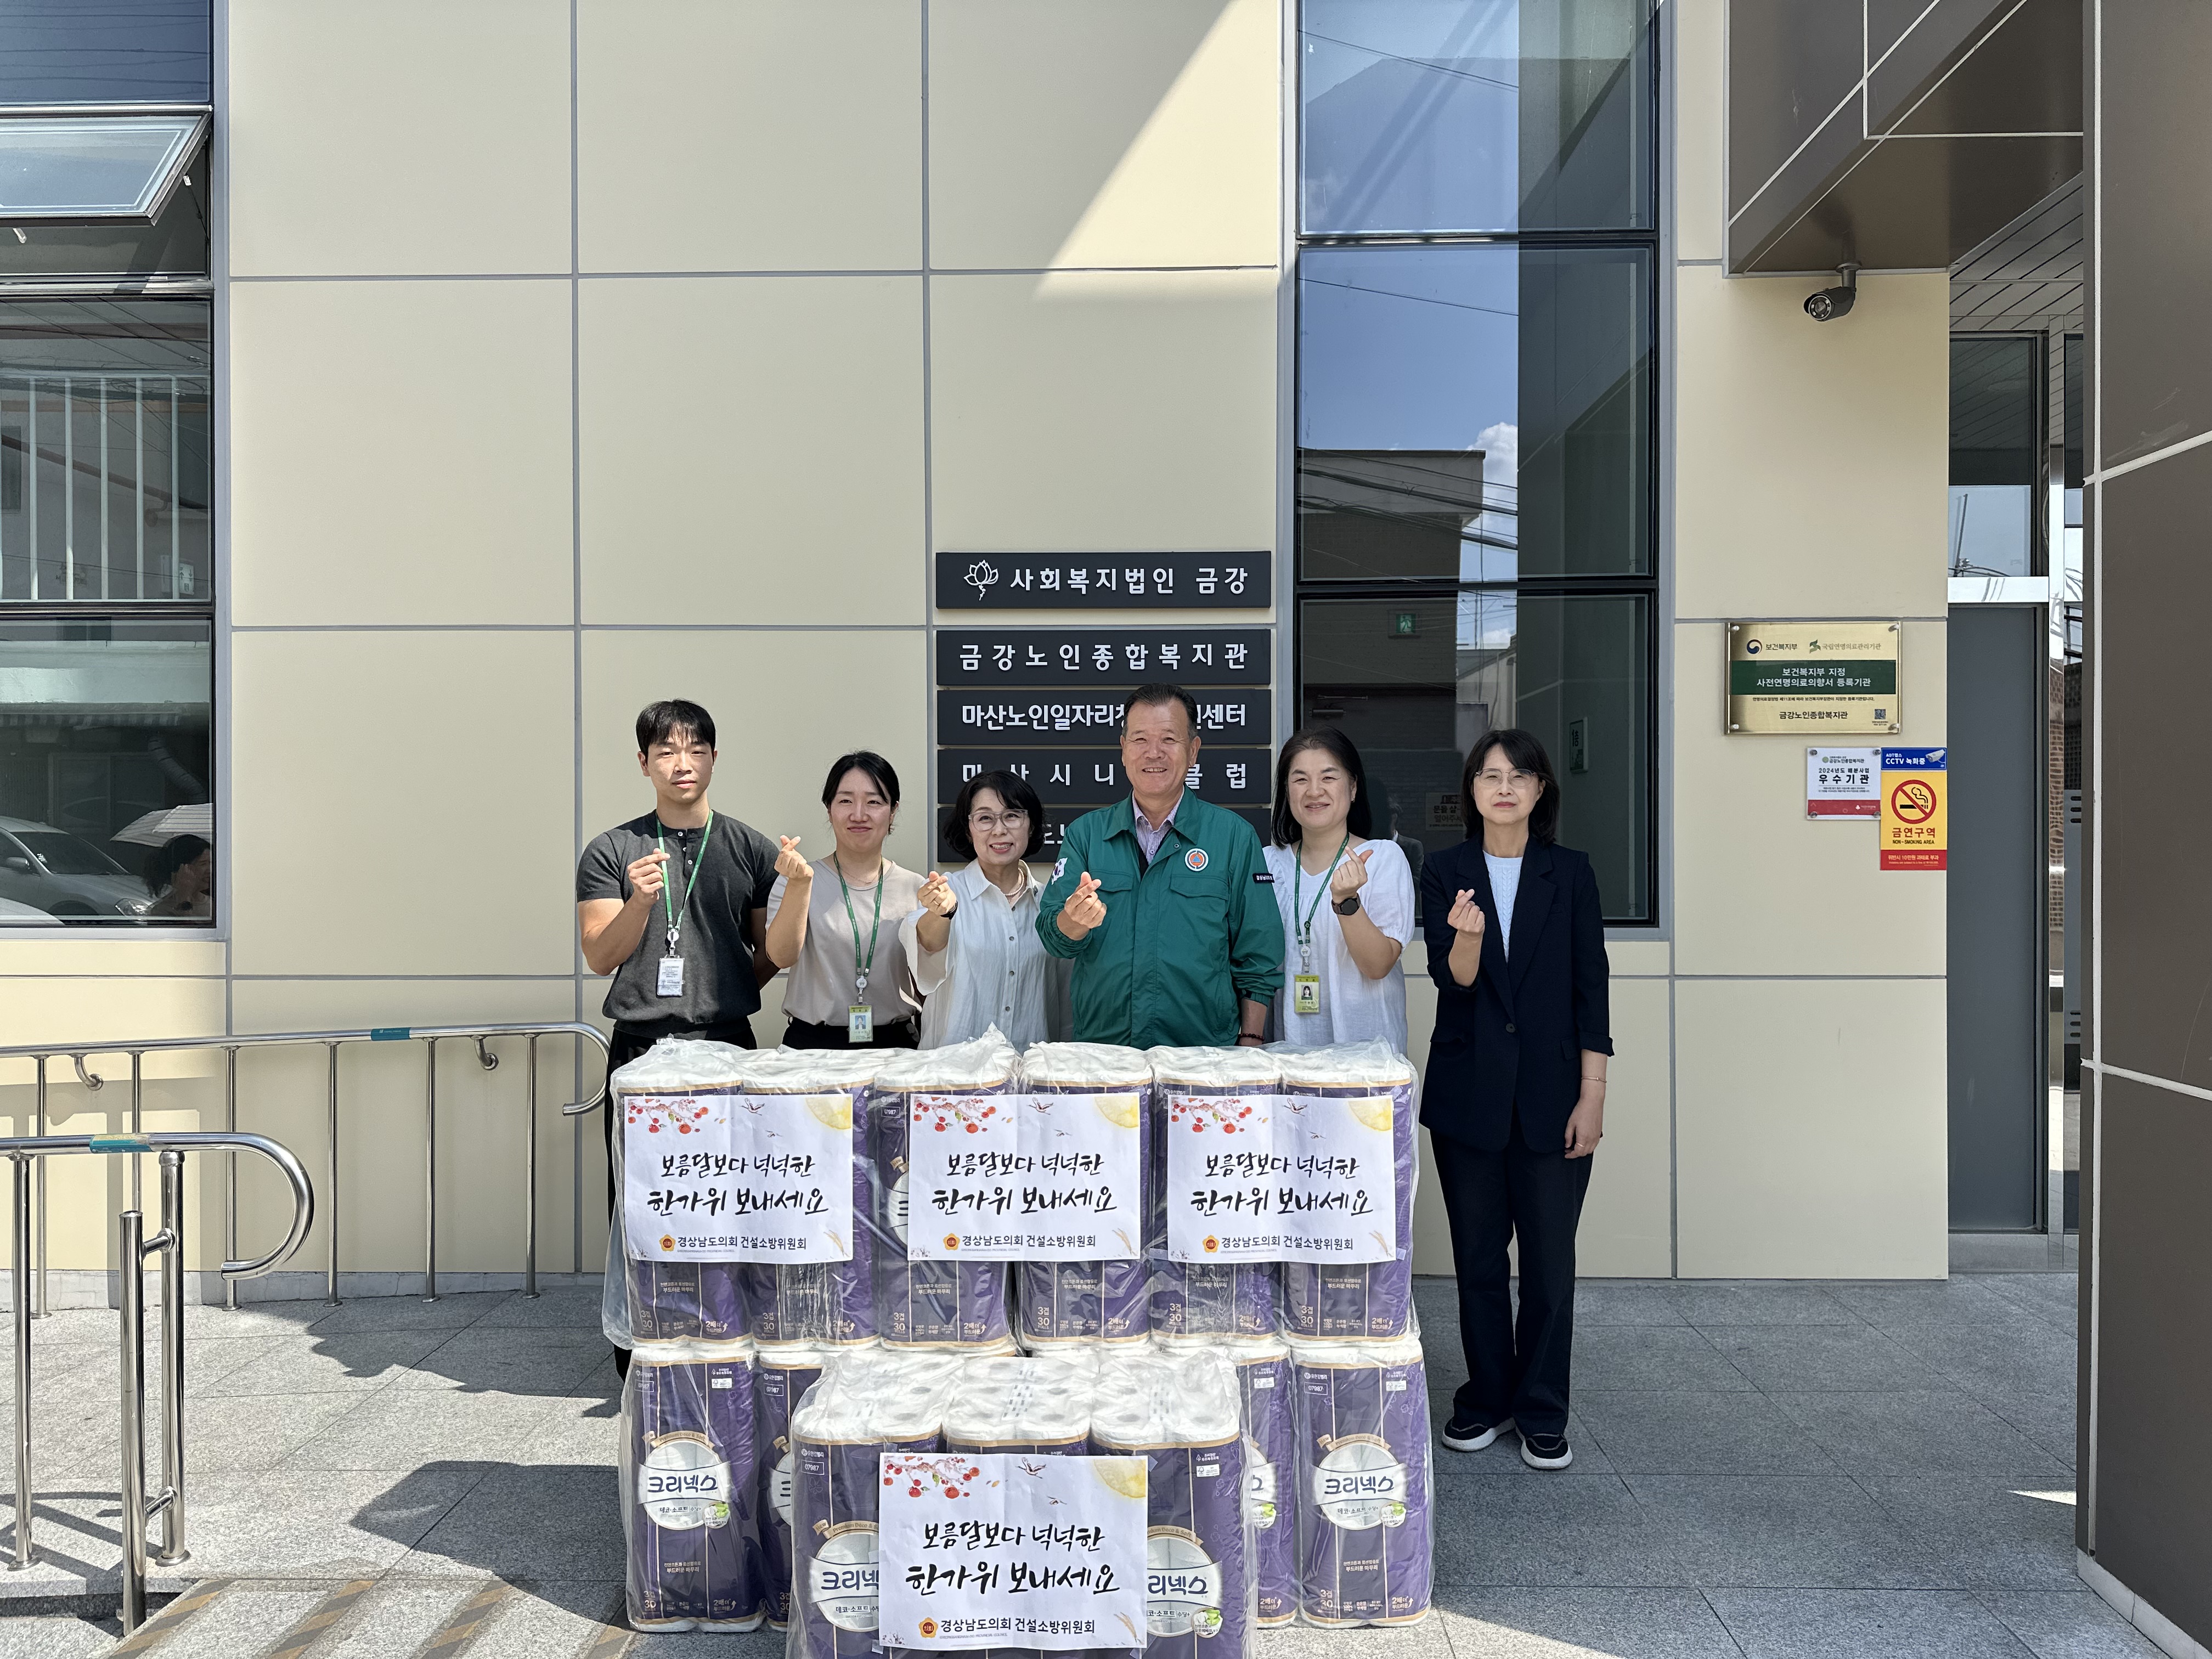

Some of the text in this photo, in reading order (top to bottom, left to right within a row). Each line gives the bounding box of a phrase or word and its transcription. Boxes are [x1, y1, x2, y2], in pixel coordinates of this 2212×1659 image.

[1010, 567, 1248, 595] 사회복지법인 금강
[960, 644, 1248, 671] 금강노인종합복지관
[1782, 668, 1846, 676] 보건복지부 지정
[1757, 678, 1871, 687] 사전연명의료의향서 등록기관
[962, 704, 1245, 730] 마산노인일자리센터
[1819, 775, 1869, 784] 우수기관
[1892, 827, 1935, 838] 금연구역
[661, 1152, 816, 1178] 보름달보다 넉넉한
[947, 1152, 1104, 1177] 보름달보다 넉넉한
[1205, 1152, 1360, 1179] 보름달보다 넉넉한
[647, 1188, 828, 1216] 한가위 보내세요
[932, 1187, 1013, 1215] 한가위
[1020, 1186, 1117, 1214] 보내세요
[1190, 1187, 1373, 1216] 한가위 보내세요
[678, 1235, 806, 1250] 경상남도의회 건설소방위원회
[962, 1234, 1096, 1248] 경상남도의회 건설소방위원회
[1221, 1235, 1353, 1250] 경상남도의회 건설소방위원회
[1037, 1306, 1049, 1316] 3겹
[1170, 1303, 1181, 1312] 3겹
[1301, 1306, 1313, 1314] 3겹
[894, 1312, 904, 1321] 3겹
[1037, 1317, 1050, 1326] 30
[1169, 1313, 1182, 1322] 30
[1301, 1316, 1313, 1324] 30
[764, 1322, 775, 1330] 30
[1335, 1437, 1355, 1446] Premium
[648, 1475, 718, 1493] 크리넥스
[1324, 1476, 1394, 1494] 크리넥스
[816, 1522, 826, 1531] New
[833, 1523, 854, 1533] Premium
[923, 1520, 1105, 1552] 보름달보다 넉넉한
[821, 1570, 879, 1590] 크리넥
[906, 1561, 1120, 1596] 한가위 보내세요
[1148, 1576, 1208, 1595] 리넥스
[1321, 1589, 1332, 1598] 3겹
[645, 1600, 656, 1608] 30
[941, 1617, 1095, 1634] 경상남도의회 건설소방위원회
